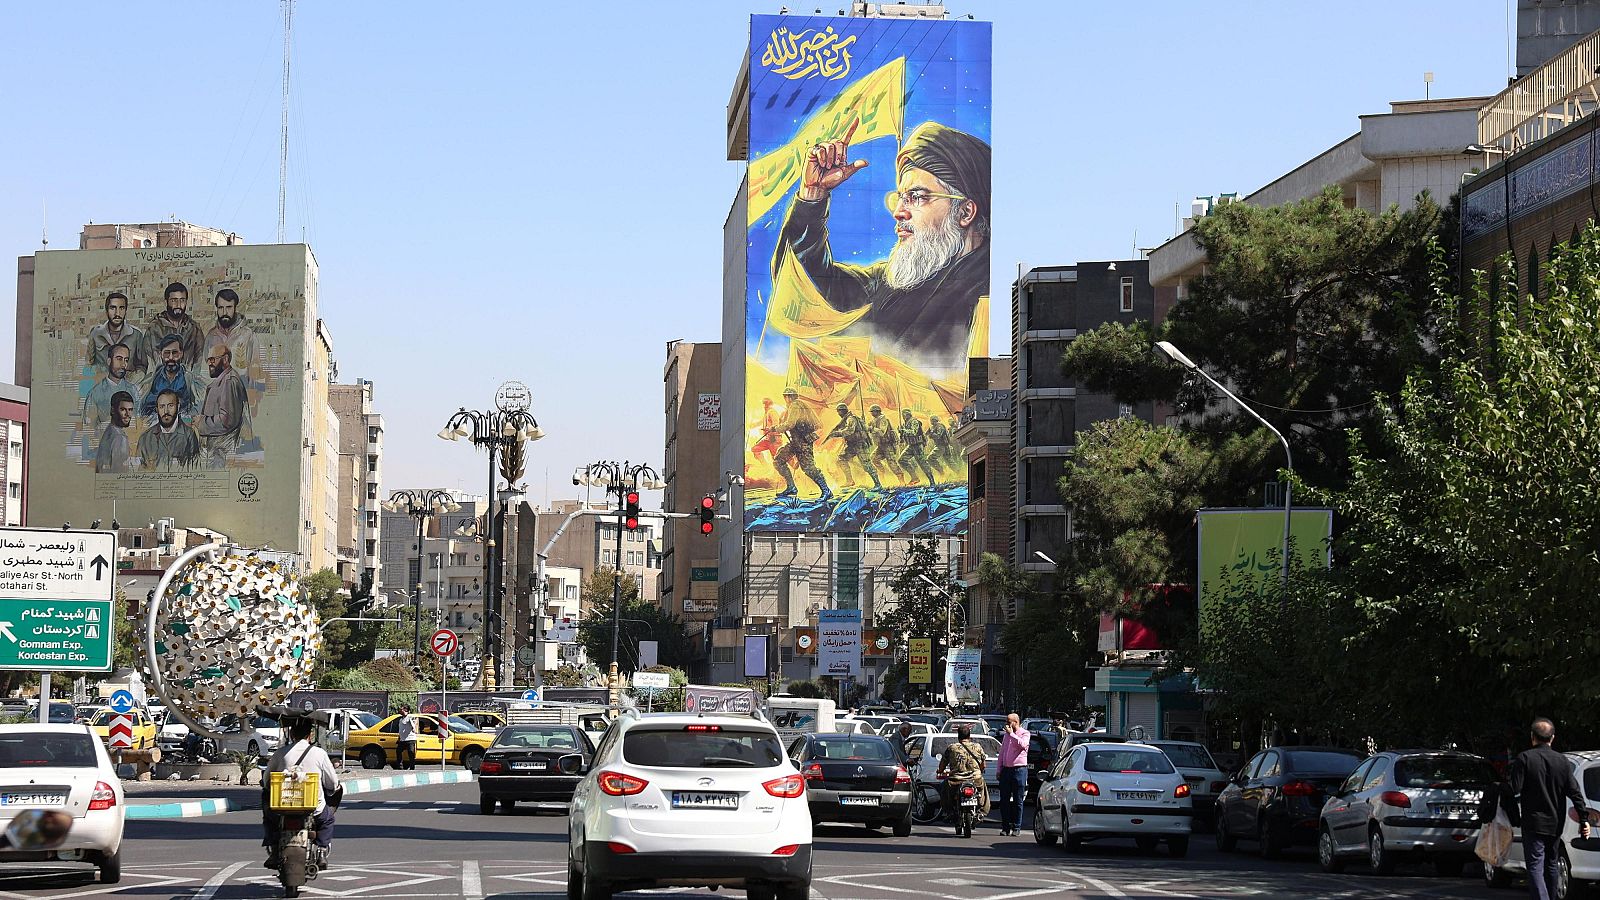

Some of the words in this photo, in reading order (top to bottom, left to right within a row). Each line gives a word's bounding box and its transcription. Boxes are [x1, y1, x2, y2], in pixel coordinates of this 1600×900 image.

[147, 251, 164, 262] اداری
[164, 252, 184, 261] تجاری
[184, 251, 213, 261] ساختمان
[499, 391, 526, 401] جهاد
[3, 556, 43, 567] مطهری
[46, 556, 75, 568] شهید
[0, 570, 22, 580] aliye
[23, 571, 39, 580] Asr
[55, 608, 84, 620] شهید
[32, 624, 84, 637] کردستان
[823, 629, 840, 638] تخفیف
[19, 640, 60, 649] Gomnam
[62, 640, 84, 650] Exp.
[18, 651, 66, 660] Kordestan
[68, 652, 89, 661] Exp.
